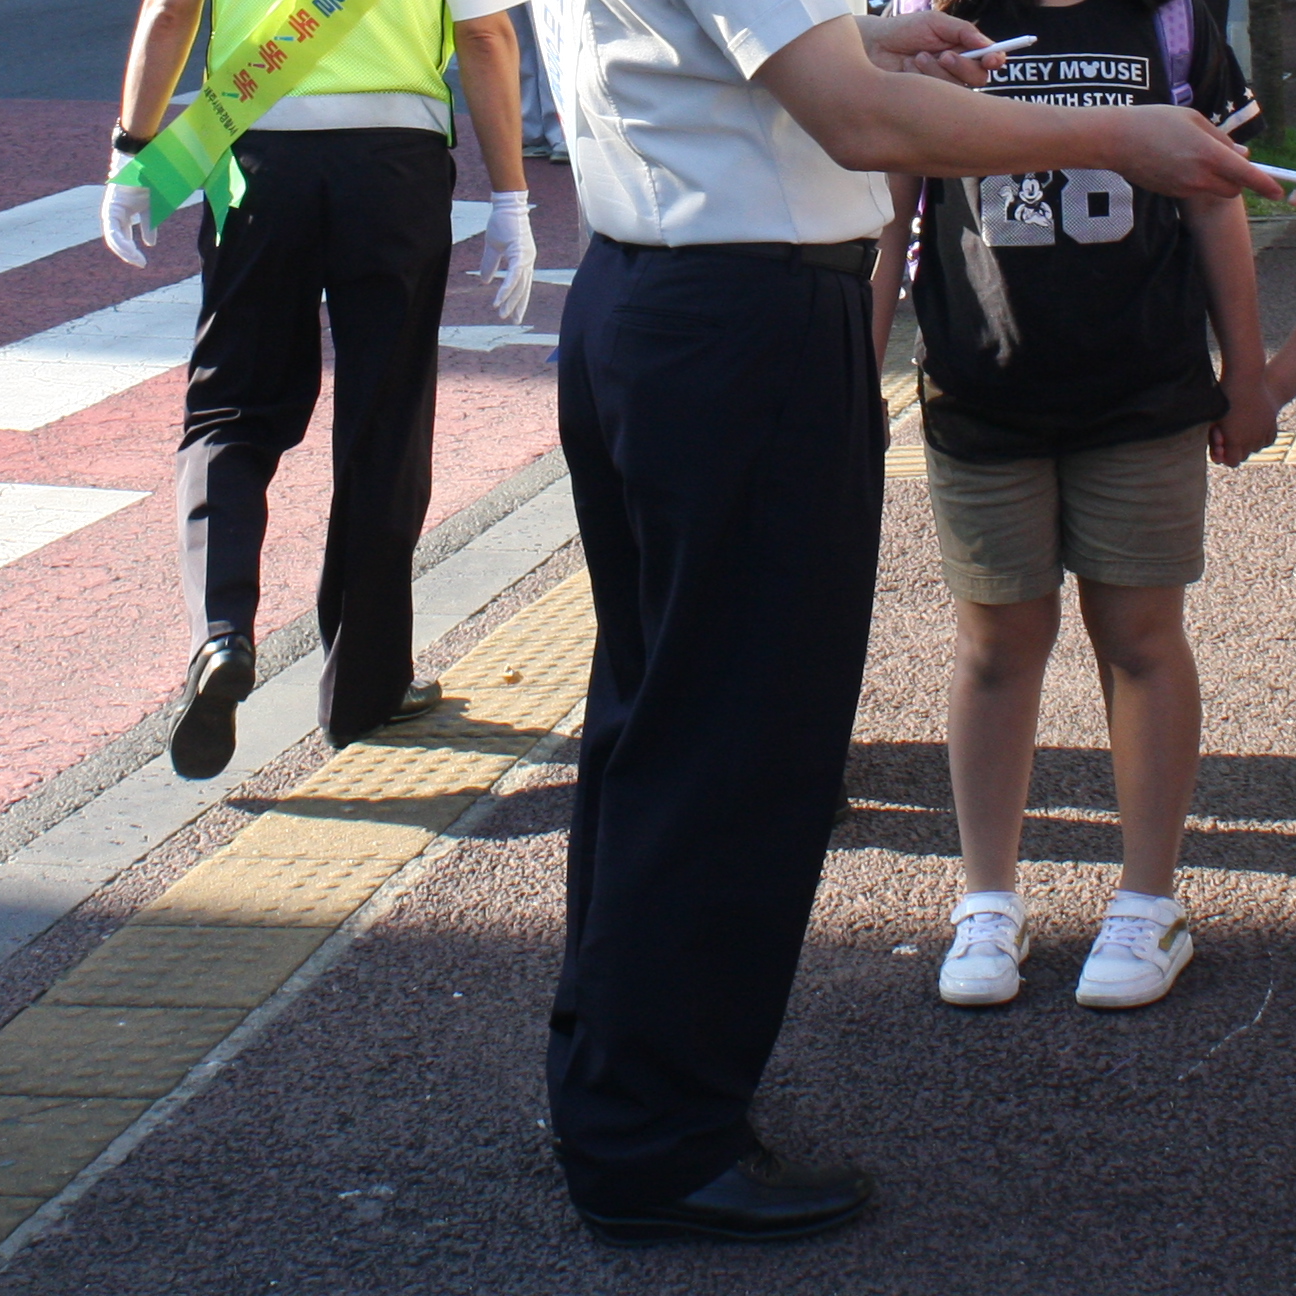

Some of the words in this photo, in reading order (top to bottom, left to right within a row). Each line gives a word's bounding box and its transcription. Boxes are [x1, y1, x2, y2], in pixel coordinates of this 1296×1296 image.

[987, 62, 1053, 83] ICKEY
[1031, 94, 1078, 107] WITH
[1083, 93, 1134, 107] STYLE
